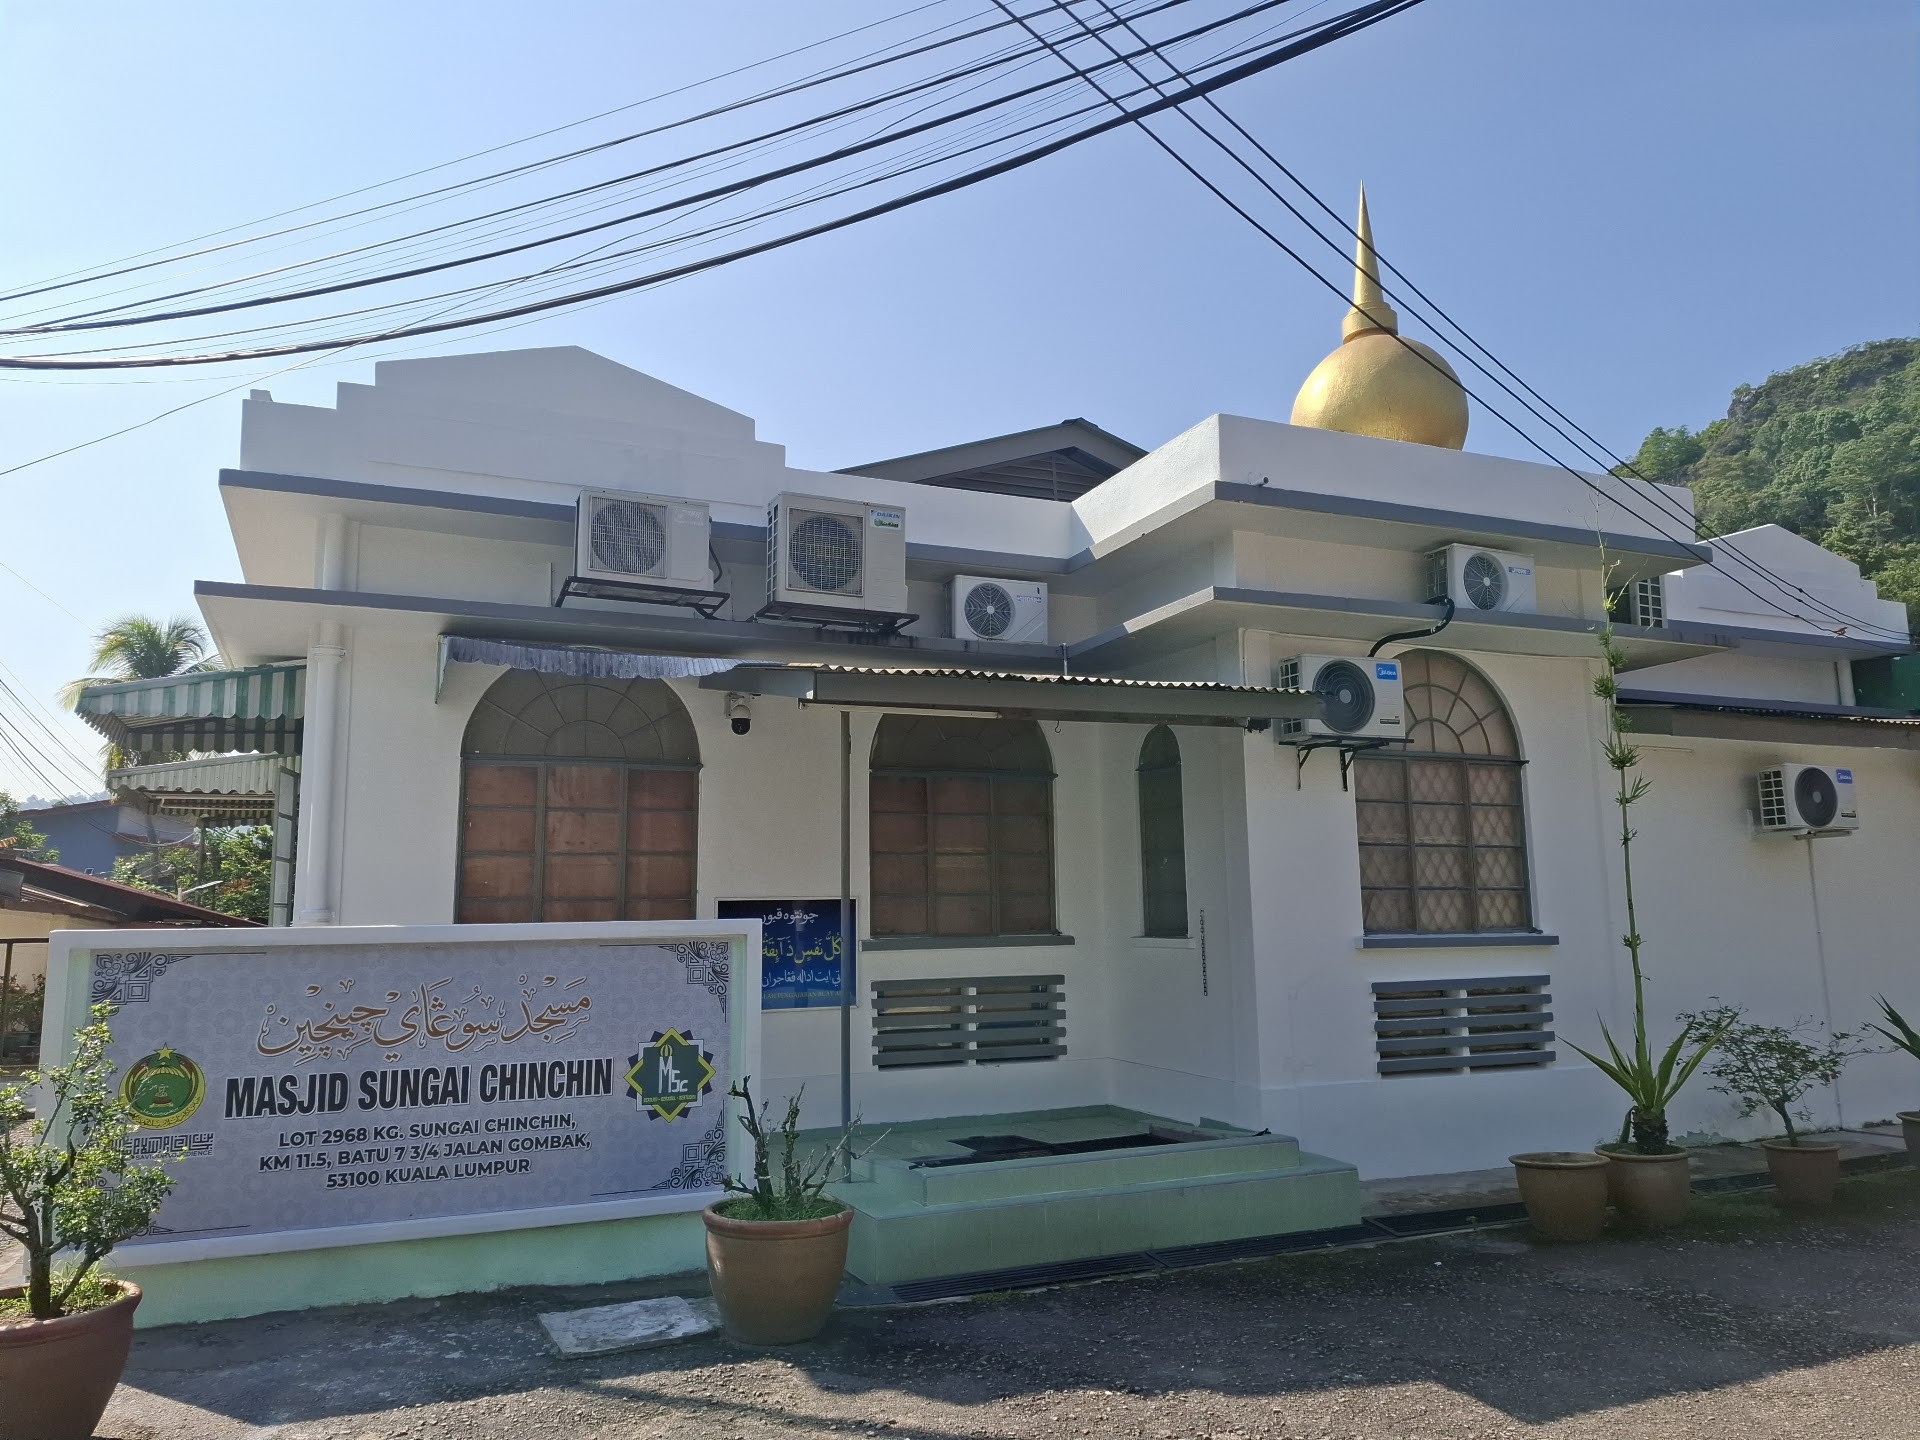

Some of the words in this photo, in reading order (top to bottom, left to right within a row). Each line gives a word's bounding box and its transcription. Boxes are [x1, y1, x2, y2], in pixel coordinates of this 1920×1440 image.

[224, 1072, 349, 1119] MASJID
[358, 1065, 471, 1111] SUNGAI
[479, 1058, 613, 1103] CHINCHIN
[279, 1130, 317, 1147] LOT
[321, 1127, 368, 1144] 2968
[373, 1125, 404, 1141] KG.
[409, 1119, 479, 1138] SUNGAI
[484, 1113, 577, 1133] CHINCHIN,
[259, 1154, 290, 1171] KM
[296, 1152, 332, 1170] 11.5,
[338, 1147, 389, 1165] BATU
[394, 1146, 406, 1161] 7
[410, 1141, 439, 1161] 3/4
[443, 1139, 503, 1157] JALAN
[508, 1133, 591, 1152] GOMBAK,
[326, 1170, 380, 1188] 53100
[385, 1165, 449, 1183] KUALA
[454, 1158, 530, 1178] LUMPUR
